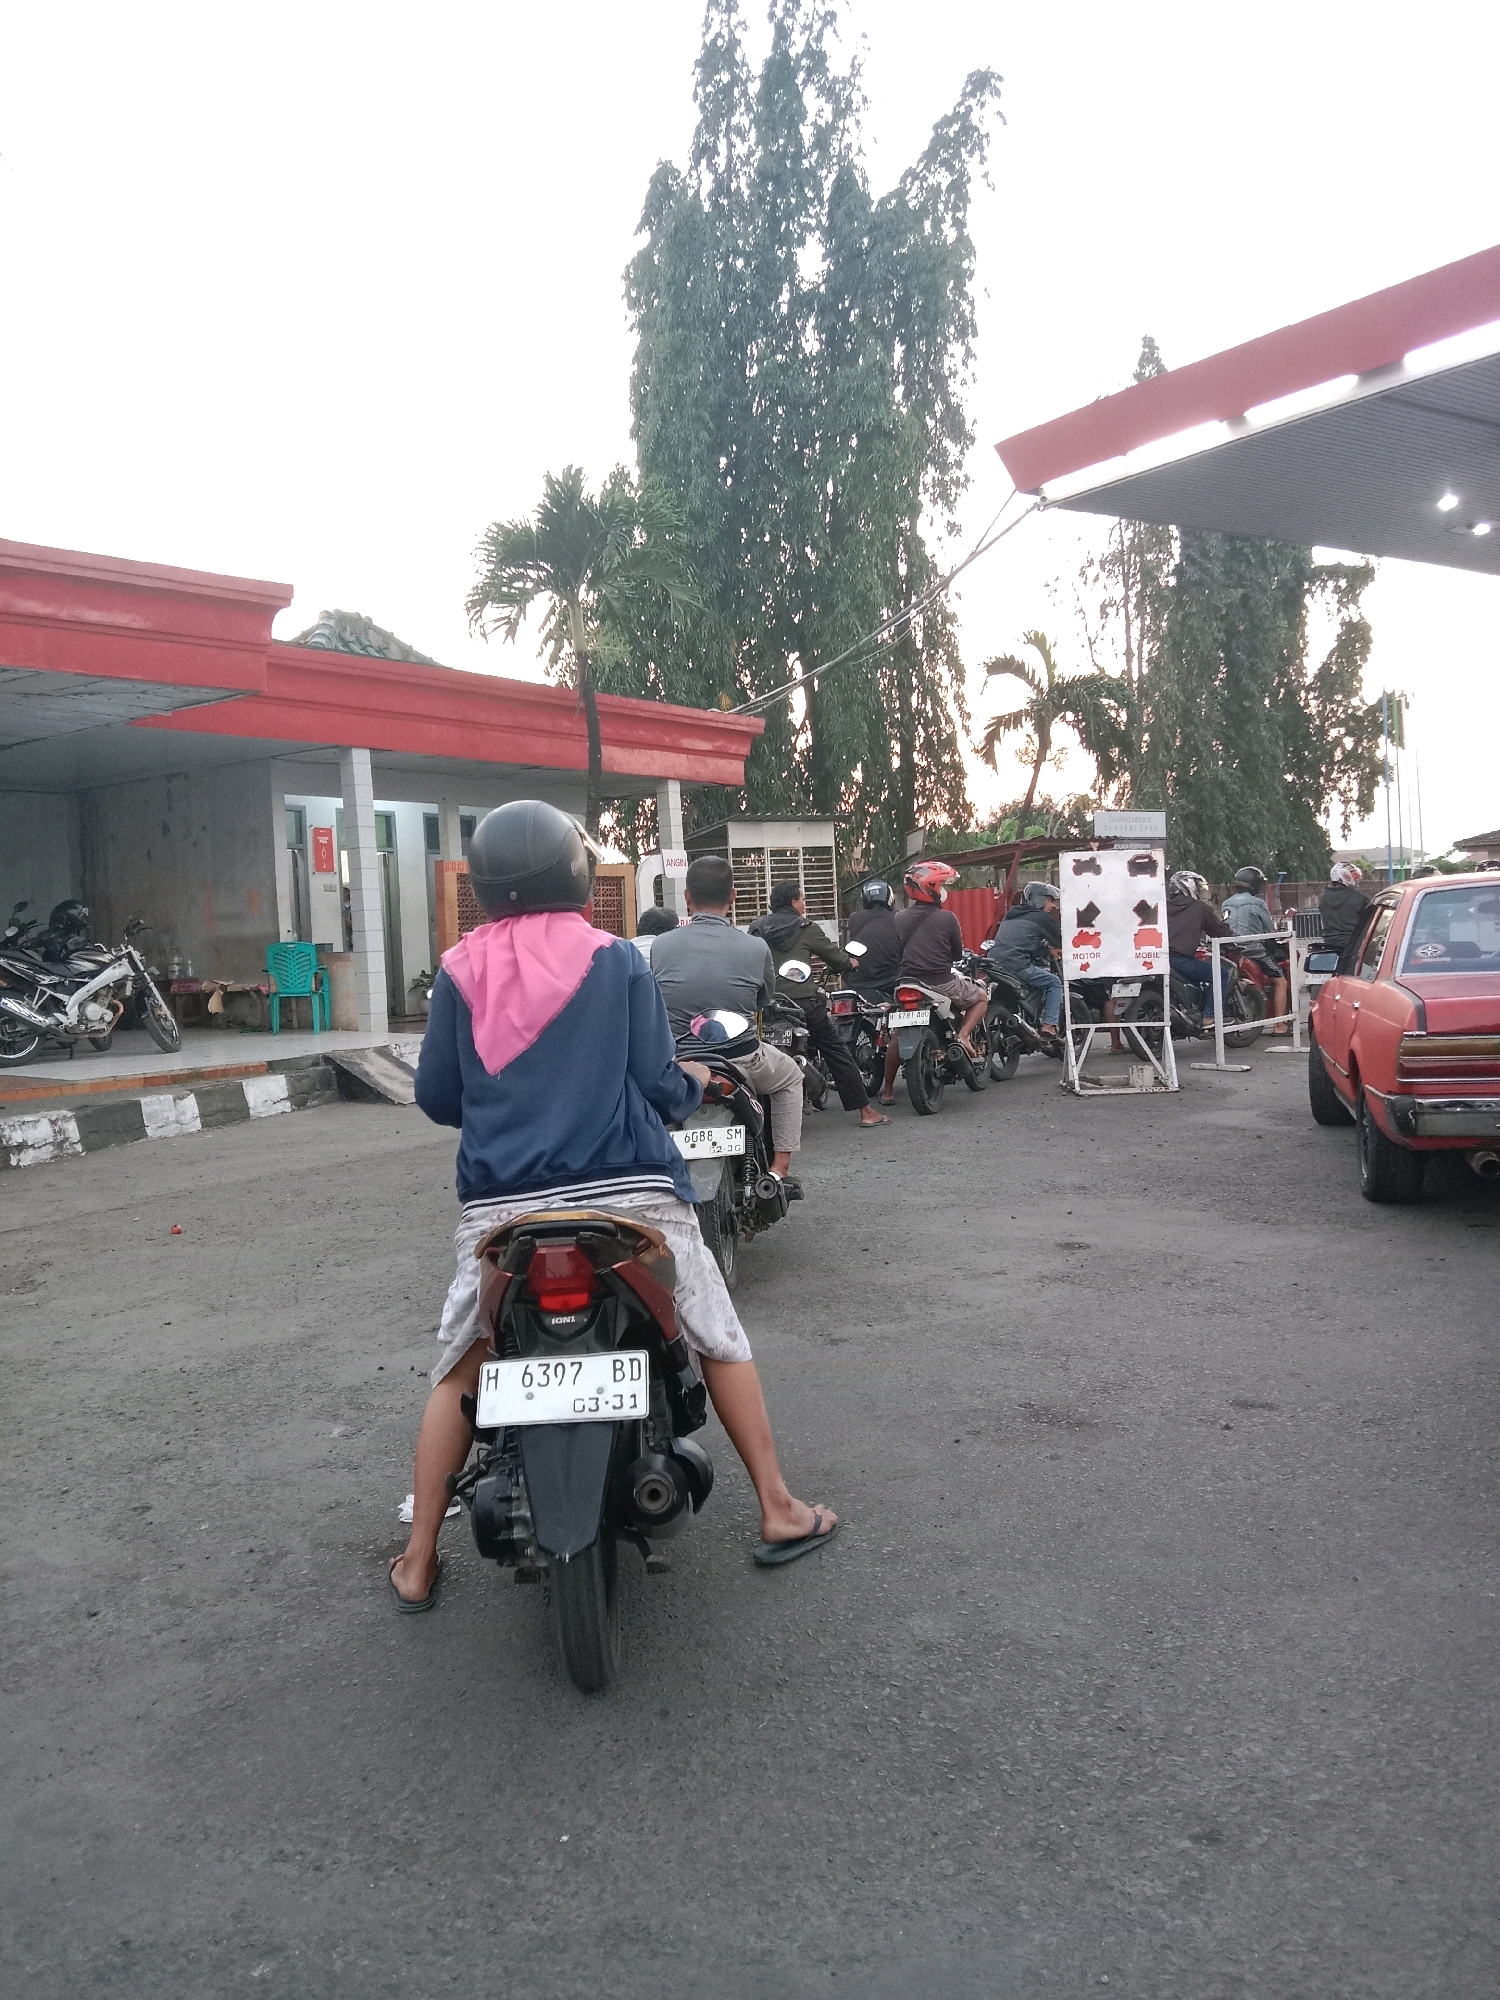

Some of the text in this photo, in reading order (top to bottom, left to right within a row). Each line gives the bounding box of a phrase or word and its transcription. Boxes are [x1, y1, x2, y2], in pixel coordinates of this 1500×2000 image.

[666, 859, 687, 867] ANGIN
[1072, 952, 1101, 960] MOTOR
[1134, 951, 1160, 959] MOBIL
[684, 1130, 713, 1143] 6088
[726, 1128, 742, 1140] SM
[485, 1357, 642, 1392] H 6397 BD
